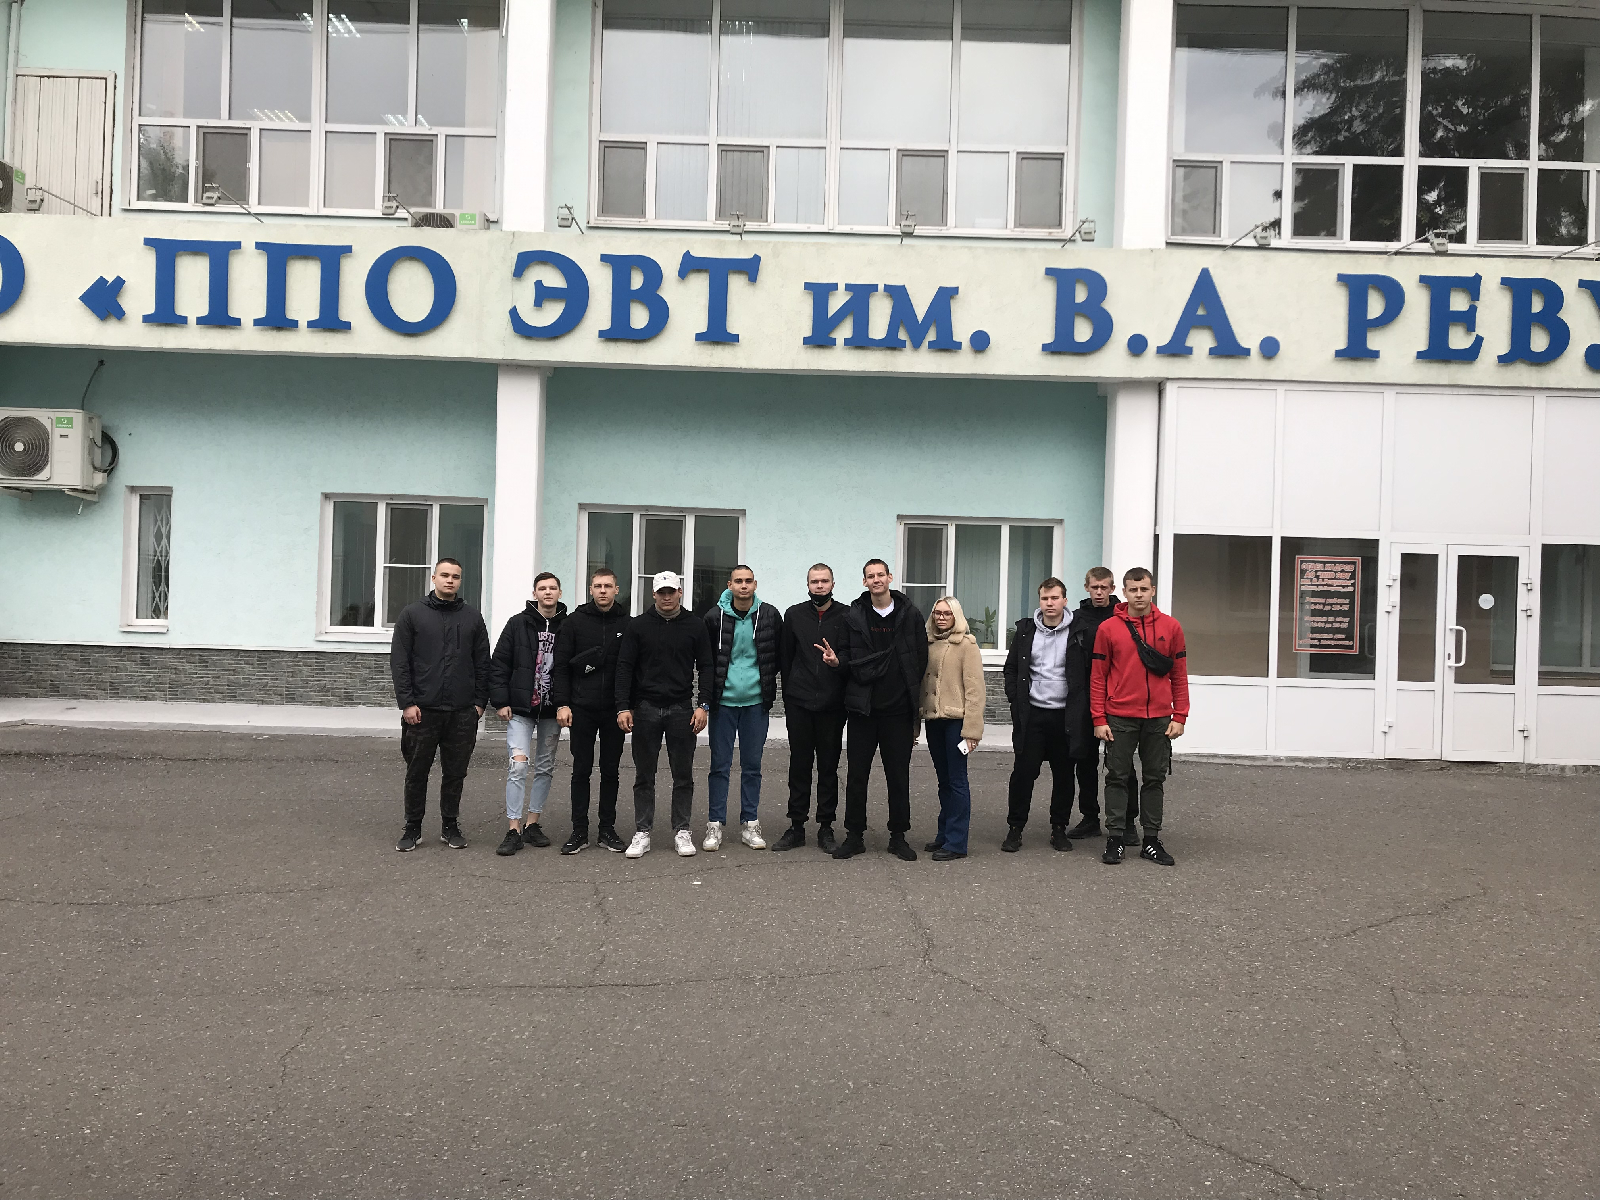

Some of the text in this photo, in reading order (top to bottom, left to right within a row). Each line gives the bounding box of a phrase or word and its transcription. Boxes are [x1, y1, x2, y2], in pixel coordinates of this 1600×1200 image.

[80, 238, 456, 333] «ППО
[509, 250, 761, 342] ЭВТ
[1042, 267, 1280, 356] В.А.
[1335, 273, 1600, 370] РЕВ
